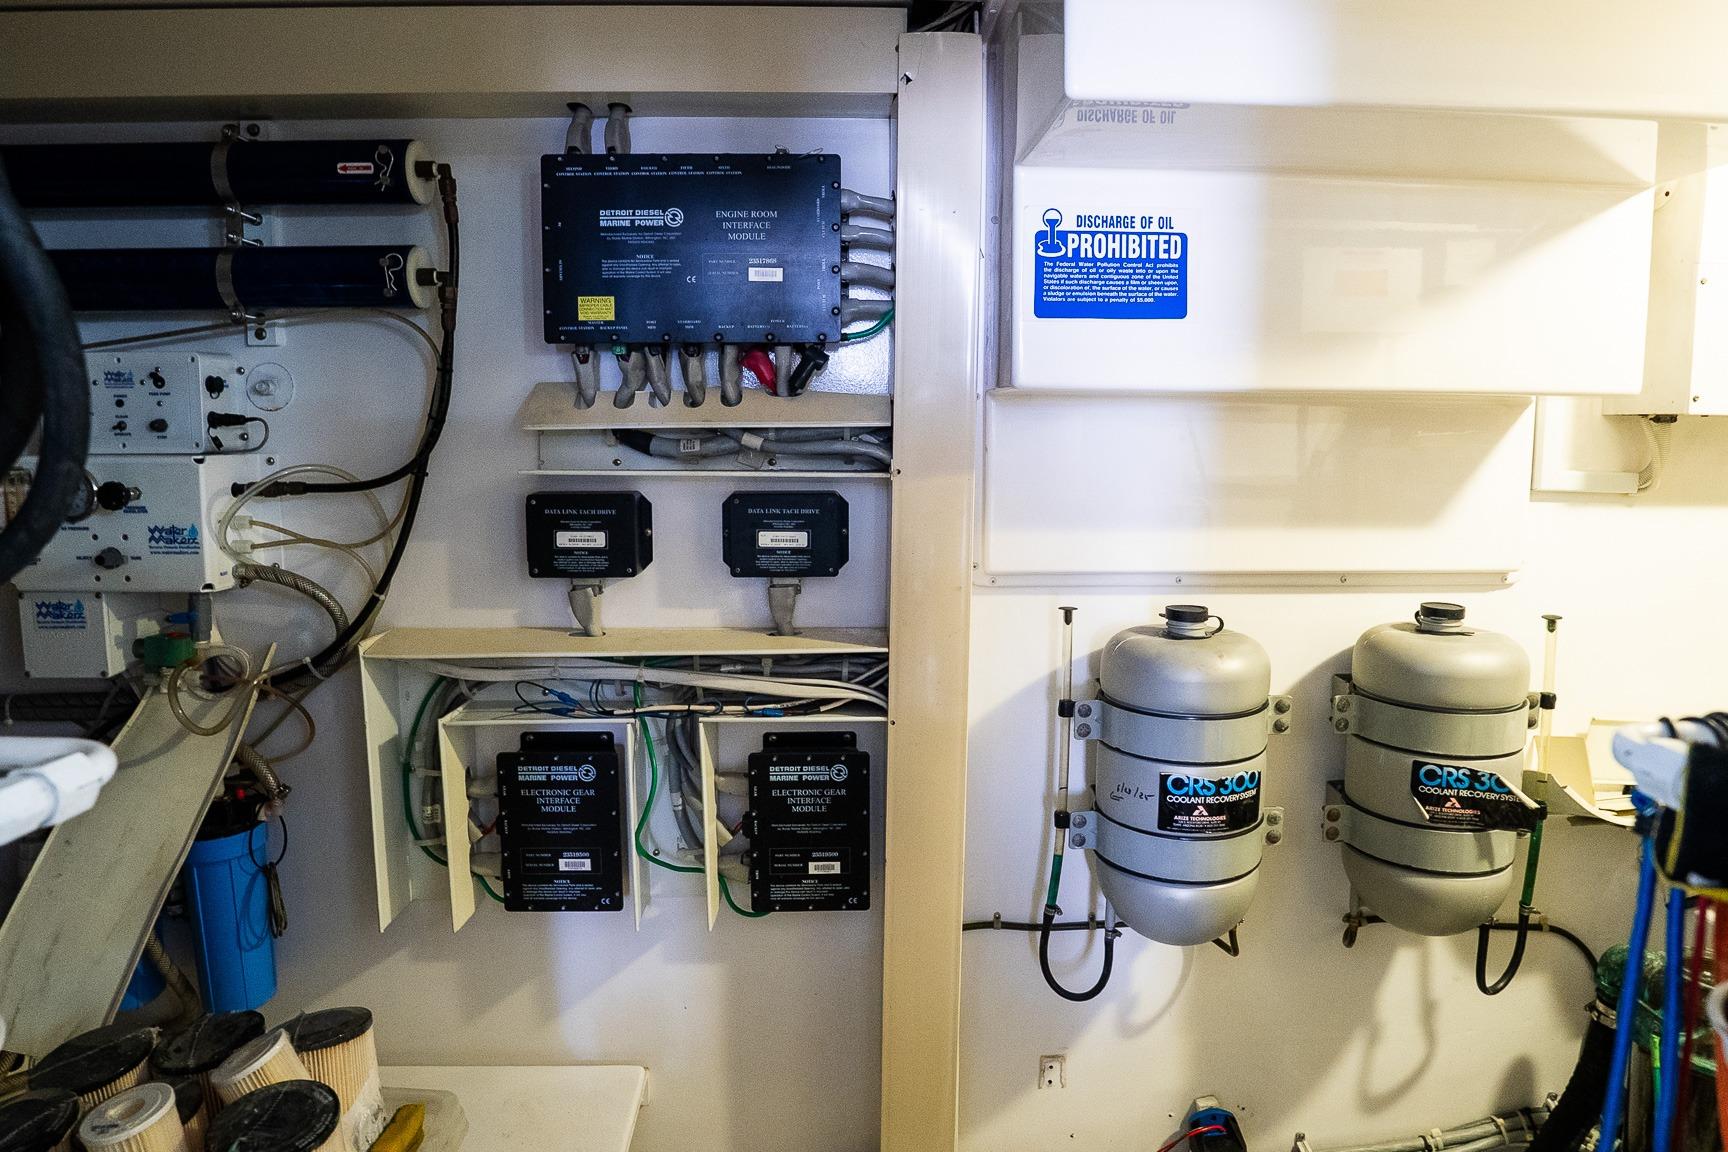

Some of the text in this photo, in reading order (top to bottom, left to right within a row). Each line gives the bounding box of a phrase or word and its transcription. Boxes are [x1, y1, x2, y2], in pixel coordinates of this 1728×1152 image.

[751, 210, 778, 218] ROOM
[723, 221, 771, 229] INTERFACE
[1077, 215, 1174, 229] DISCHARGE OF OIL
[1067, 233, 1182, 259] PROHIBITED
[148, 524, 187, 536] Water
[35, 599, 73, 610] Water
[1167, 770, 1258, 796] CRS 300
[1419, 764, 1470, 789] CRS
[1167, 789, 1257, 804] COOLANT RECOVERY SYSTEM
[1419, 785, 1458, 796] COOLANT
[1459, 789, 1501, 800] RECOVERY
